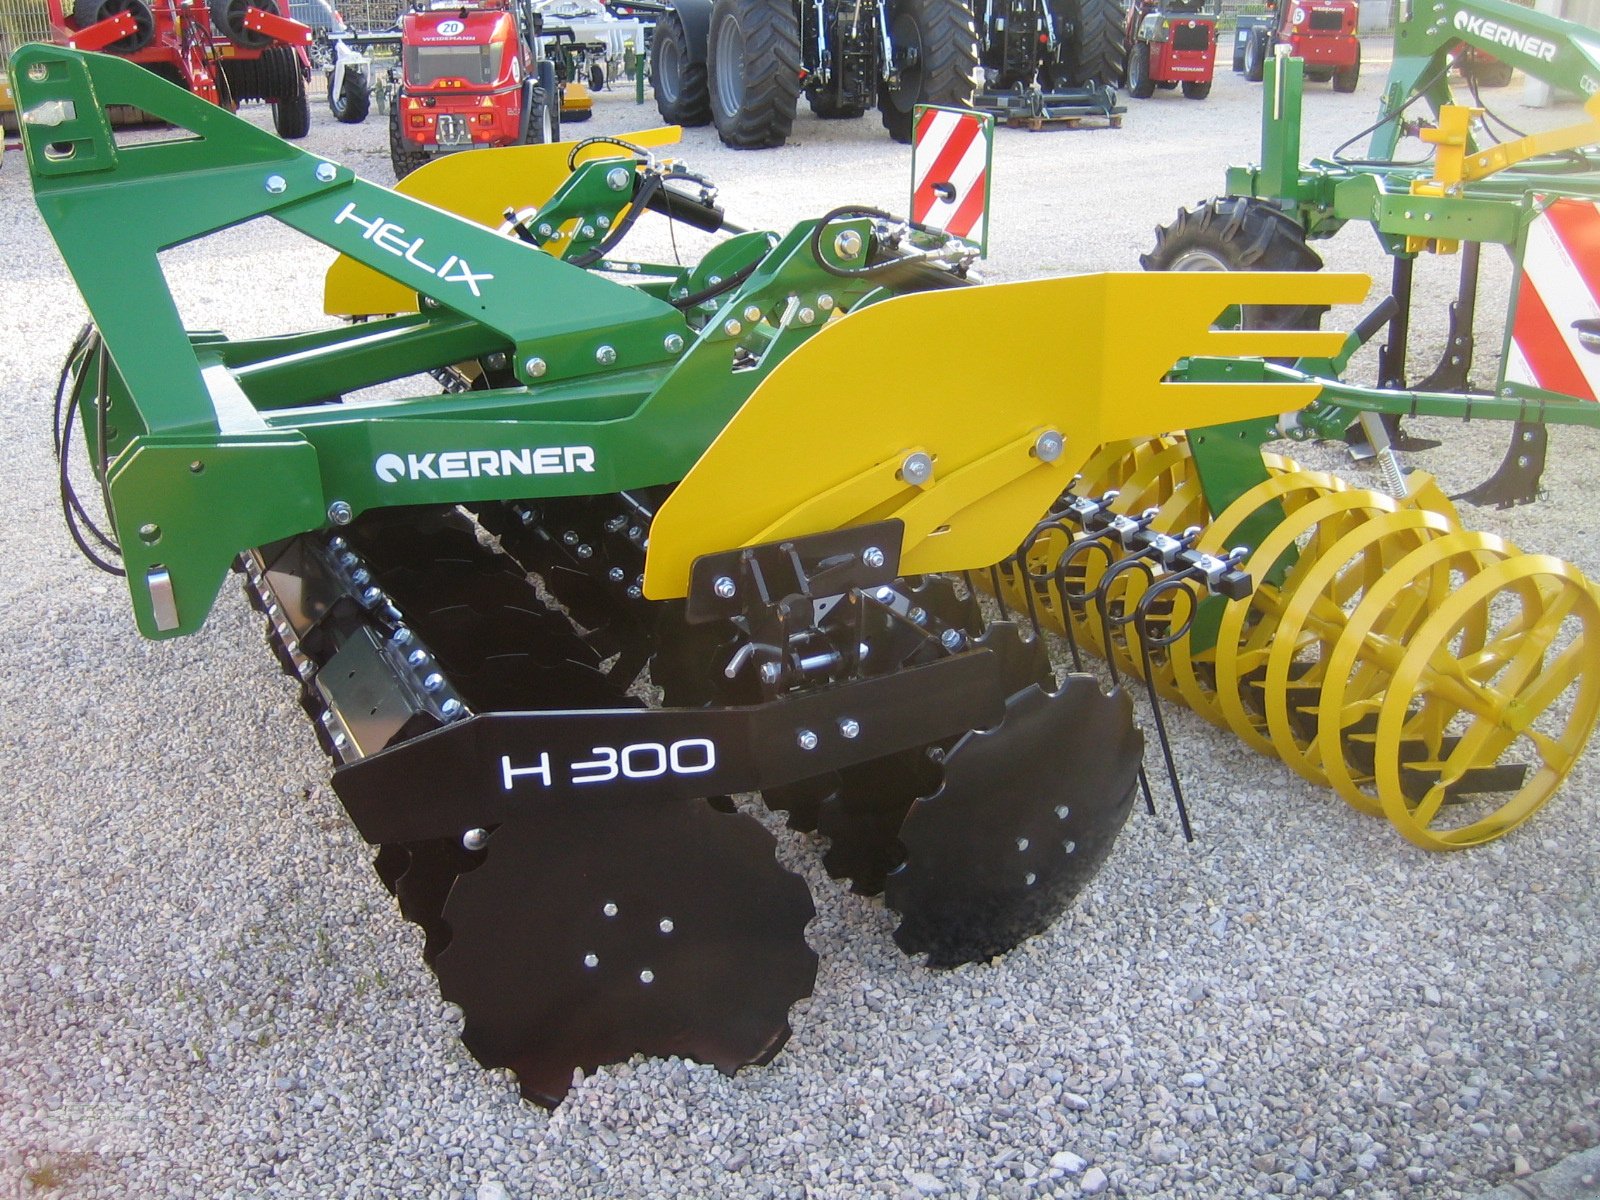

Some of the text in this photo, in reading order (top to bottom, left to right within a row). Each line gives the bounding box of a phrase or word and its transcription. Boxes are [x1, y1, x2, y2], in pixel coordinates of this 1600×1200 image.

[442, 23, 459, 33] 20
[1467, 15, 1556, 62] KERNER
[334, 202, 494, 297] HELIX
[407, 445, 596, 480] KERNER
[501, 738, 716, 790] H 300
